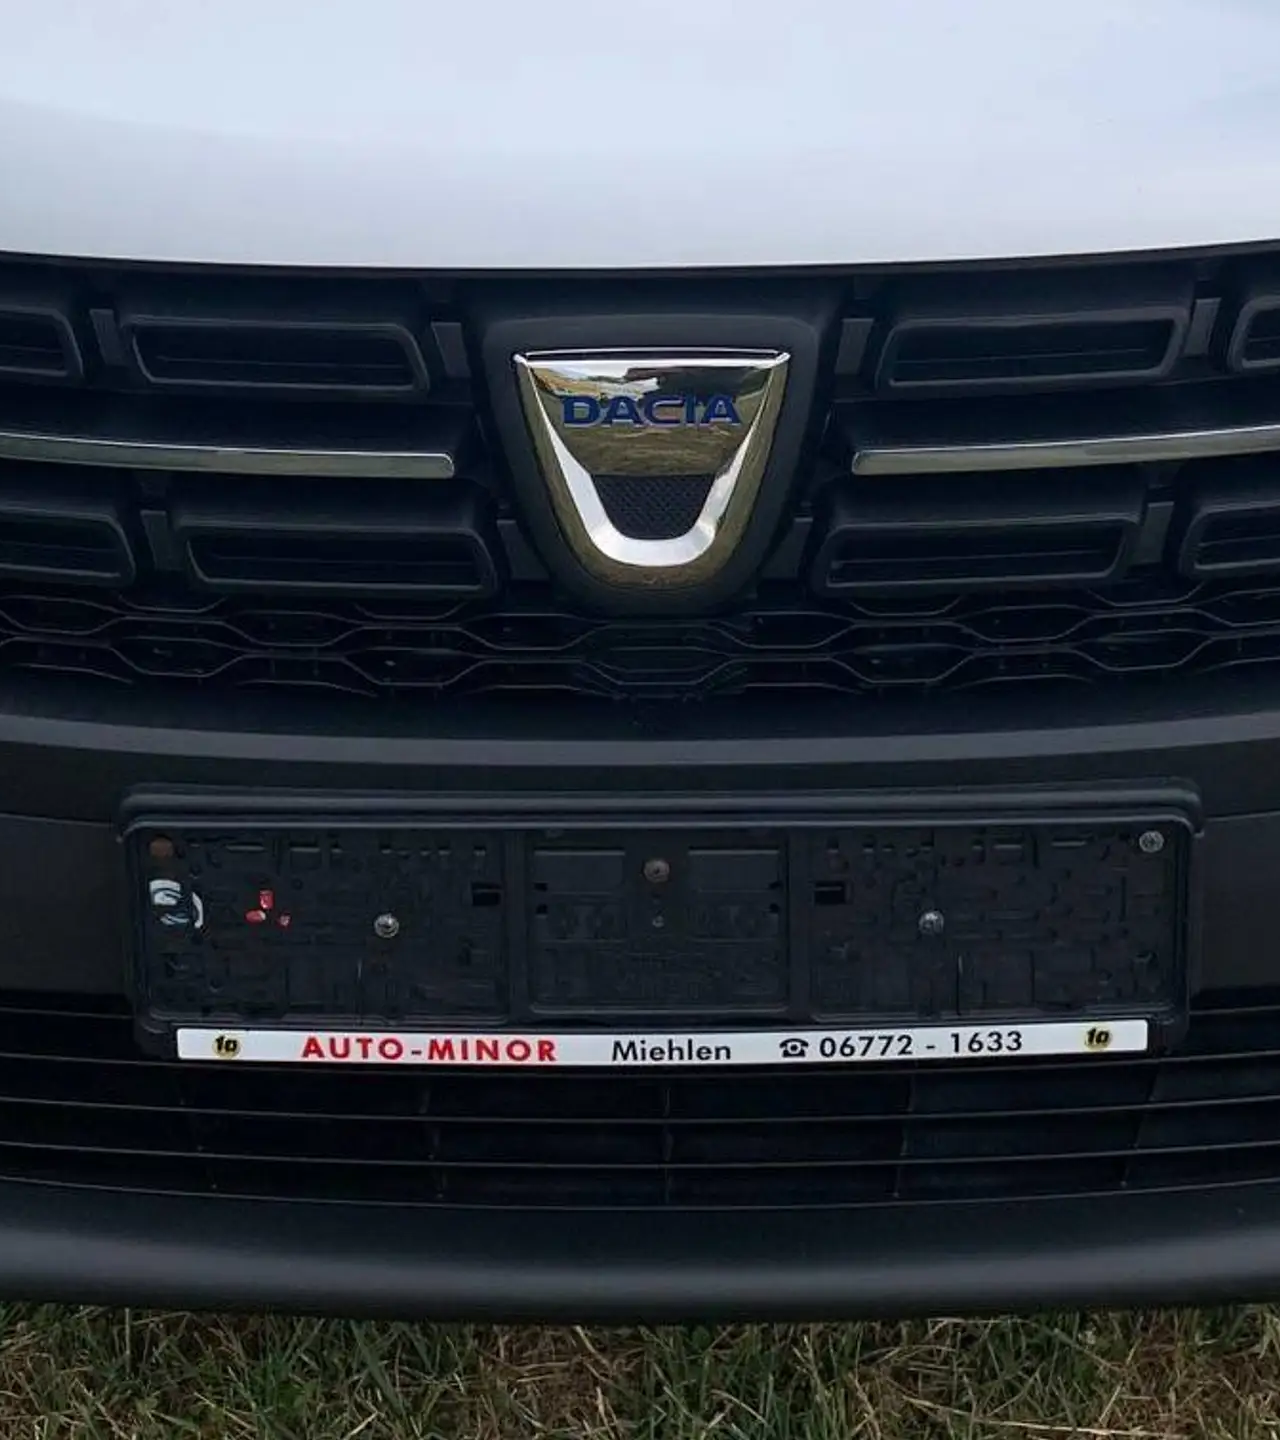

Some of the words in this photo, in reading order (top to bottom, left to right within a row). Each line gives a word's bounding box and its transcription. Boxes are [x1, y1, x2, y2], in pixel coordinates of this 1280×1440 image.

[562, 393, 743, 427] DACIA
[301, 1035, 558, 1063] AUTO-MINOR
[611, 1038, 732, 1062] Miehlen
[818, 1034, 914, 1058] 06772
[951, 1029, 1023, 1054] 1633
